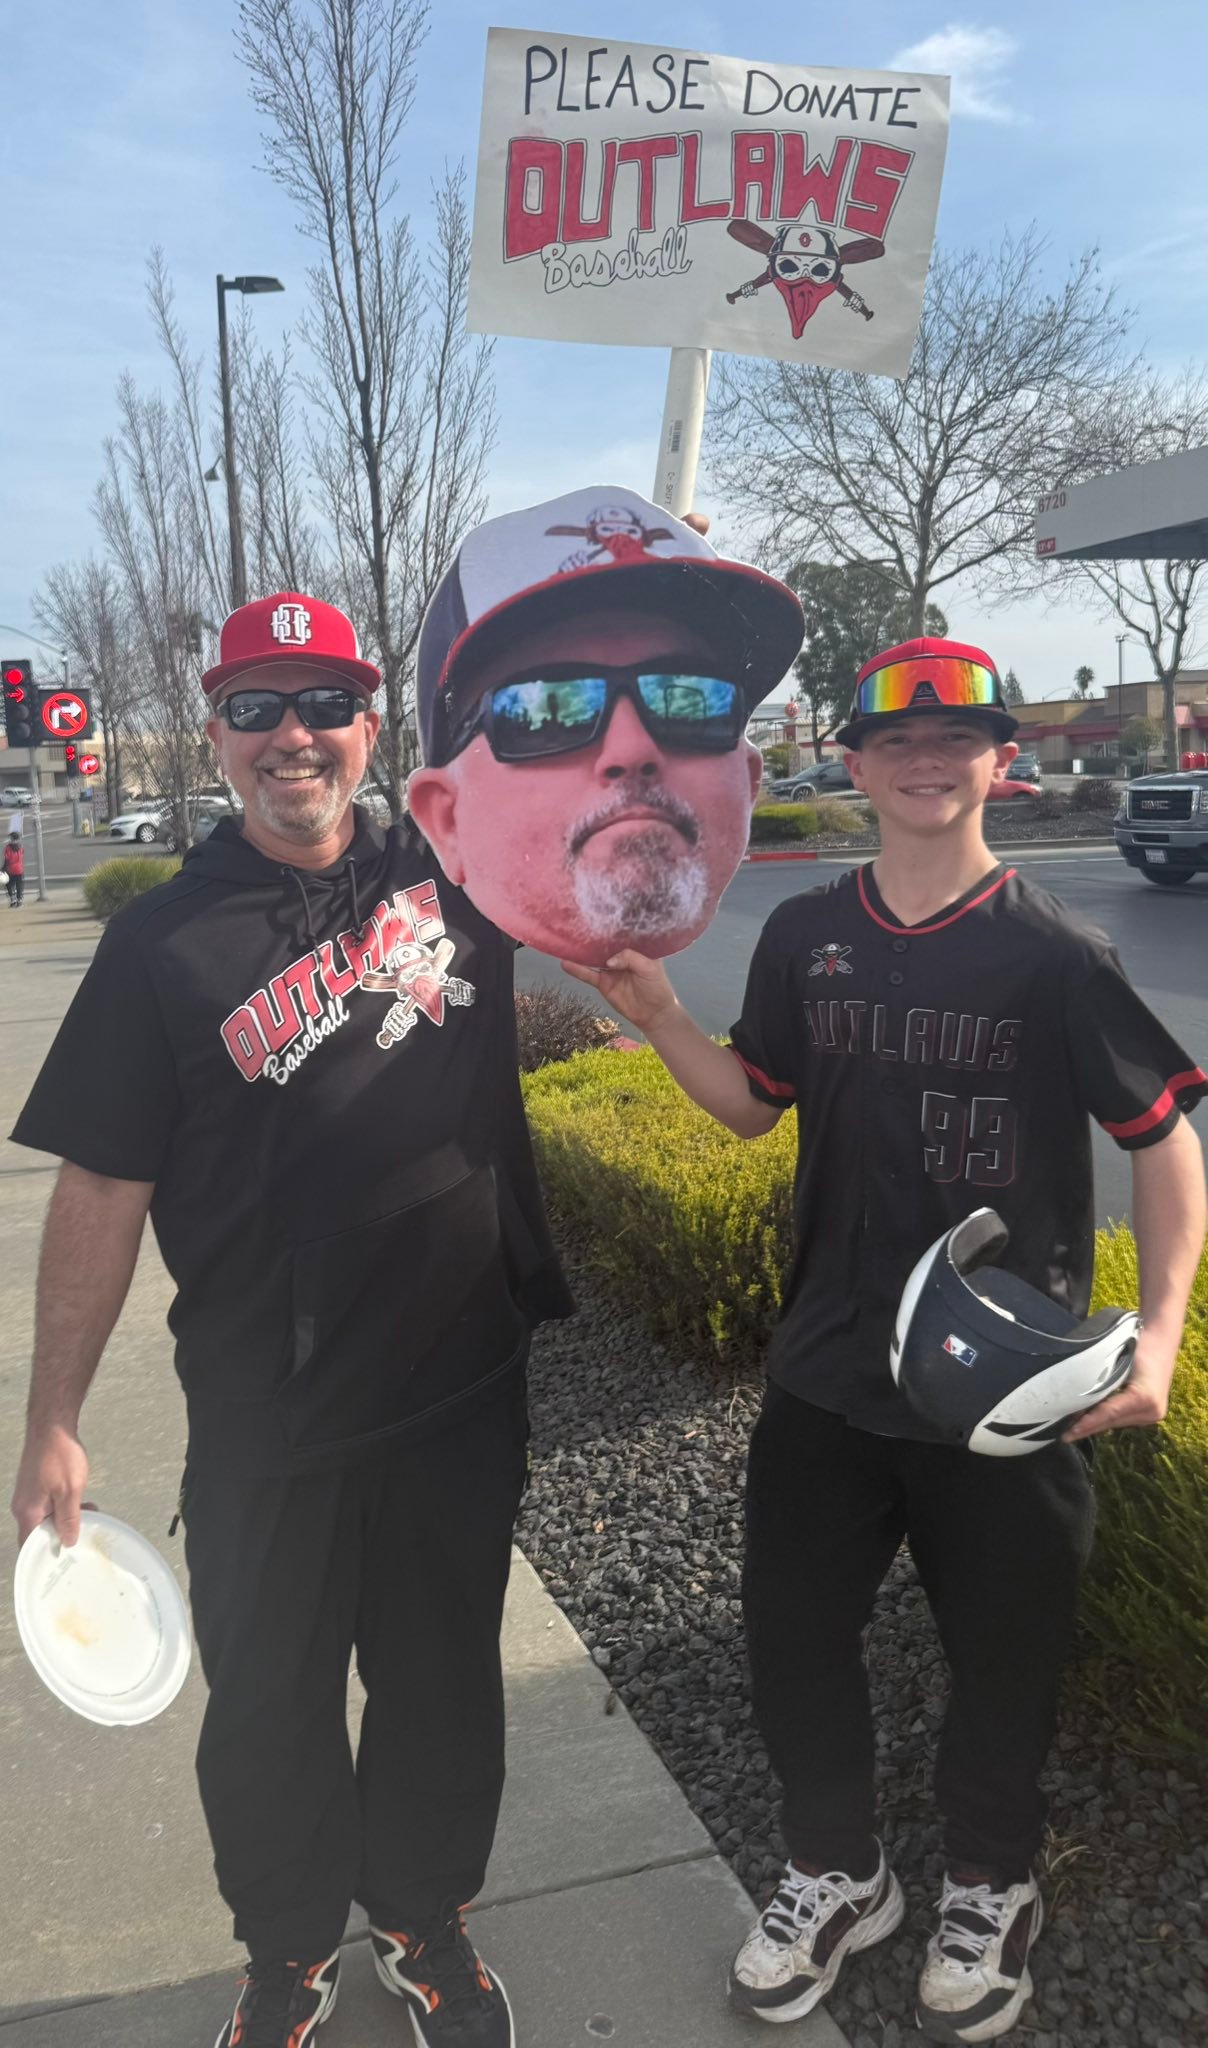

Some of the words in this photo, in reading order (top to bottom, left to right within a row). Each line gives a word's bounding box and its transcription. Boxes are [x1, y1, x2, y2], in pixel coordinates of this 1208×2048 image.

[524, 44, 709, 115] PLEASE
[743, 70, 921, 129] DONATE
[504, 130, 914, 263] OUTLAWS
[540, 225, 693, 294] Baseball
[1038, 492, 1066, 513] 6720
[220, 879, 445, 1082] OUTLAWS
[262, 995, 350, 1085] Baseball
